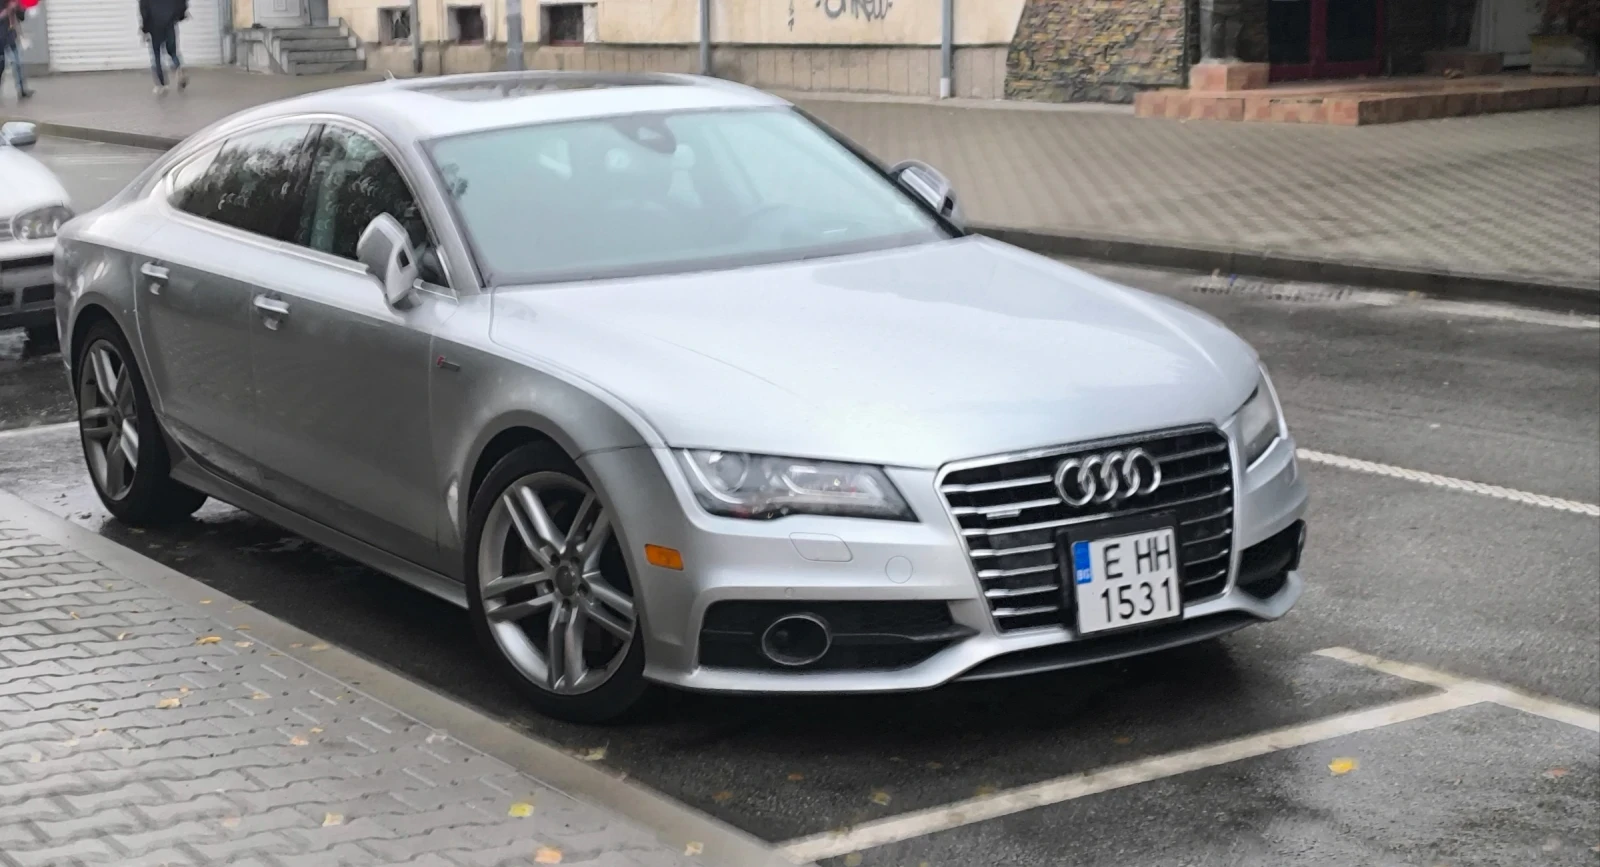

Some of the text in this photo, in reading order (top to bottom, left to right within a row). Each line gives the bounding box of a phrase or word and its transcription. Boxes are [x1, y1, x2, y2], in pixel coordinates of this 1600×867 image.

[1103, 534, 1172, 580] E HH
[1101, 577, 1172, 623] 1531
